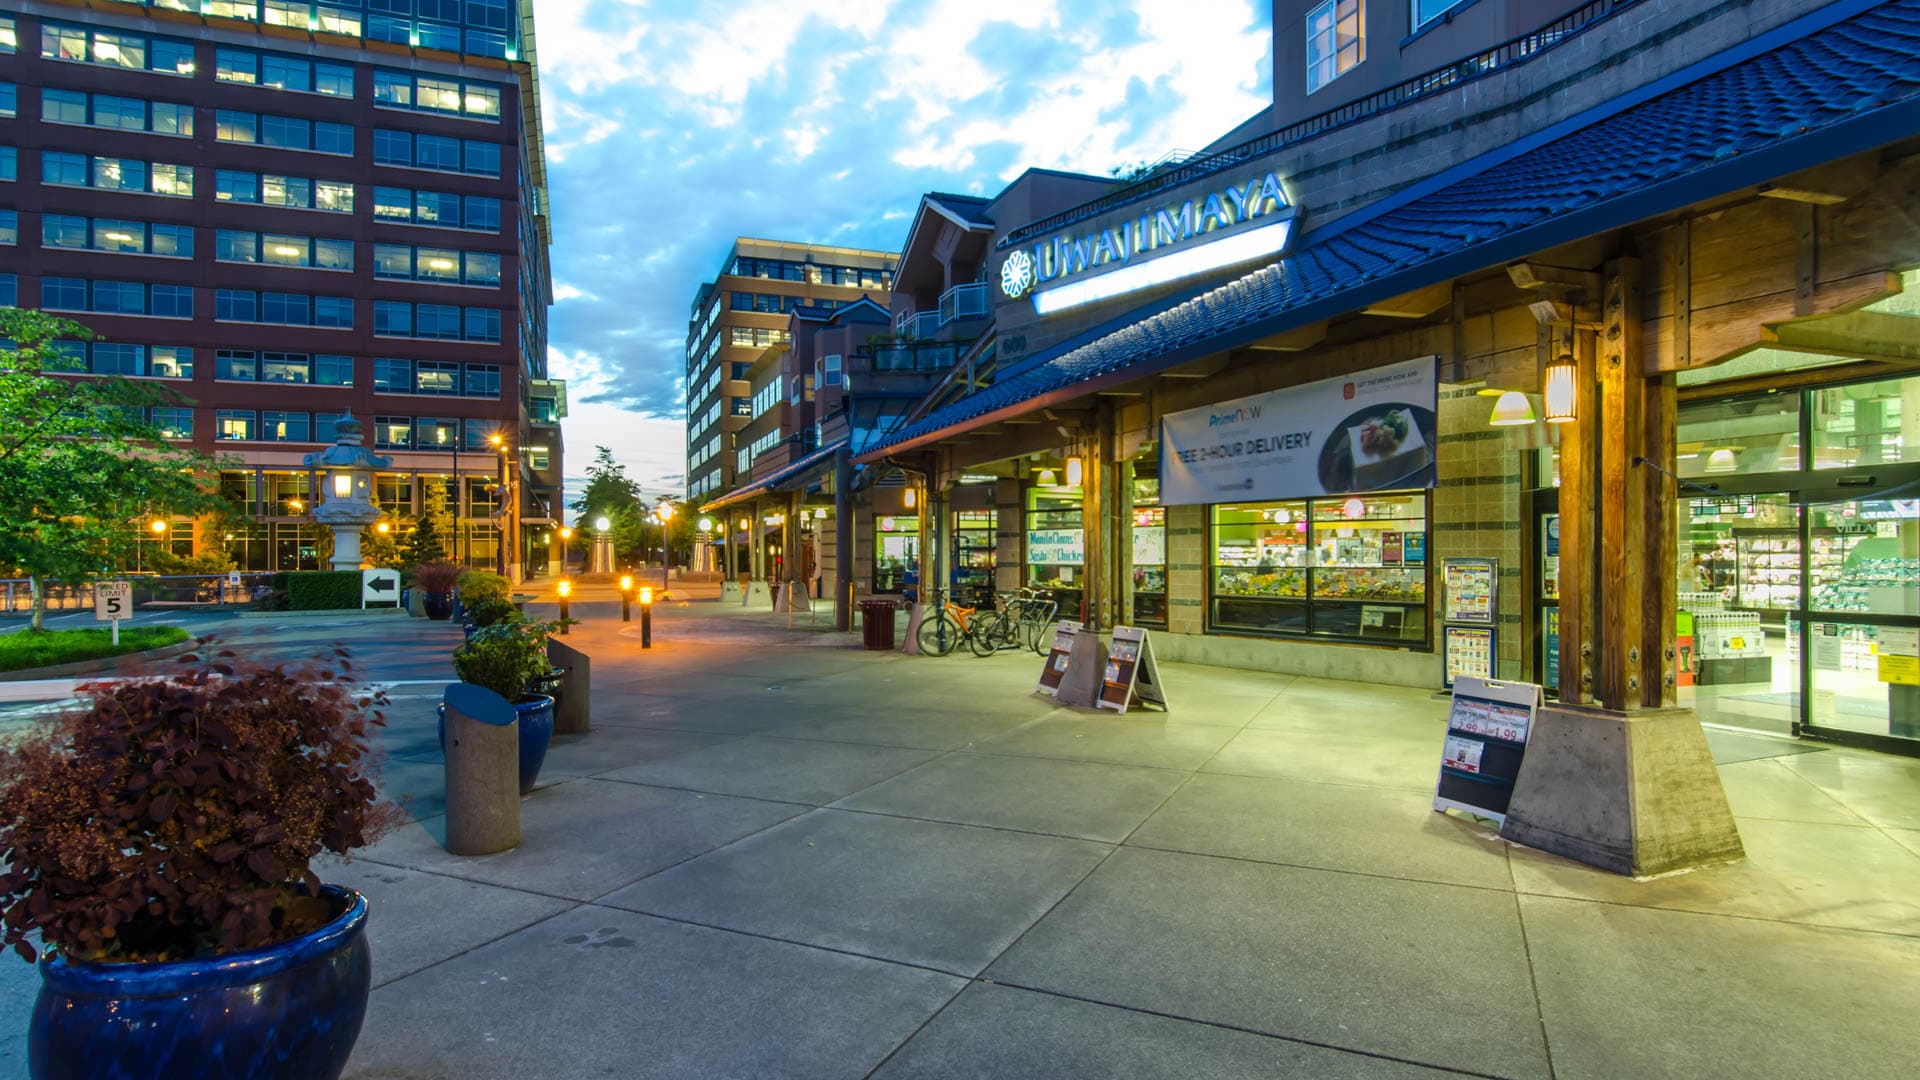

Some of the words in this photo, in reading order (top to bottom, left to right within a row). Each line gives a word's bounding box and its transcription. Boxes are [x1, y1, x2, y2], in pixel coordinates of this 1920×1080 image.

[1034, 172, 1289, 283] UWAJIMAYA
[1200, 442, 1244, 462] 2-HOUR
[1246, 430, 1313, 455] DELIVERY
[107, 597, 121, 614] 5
